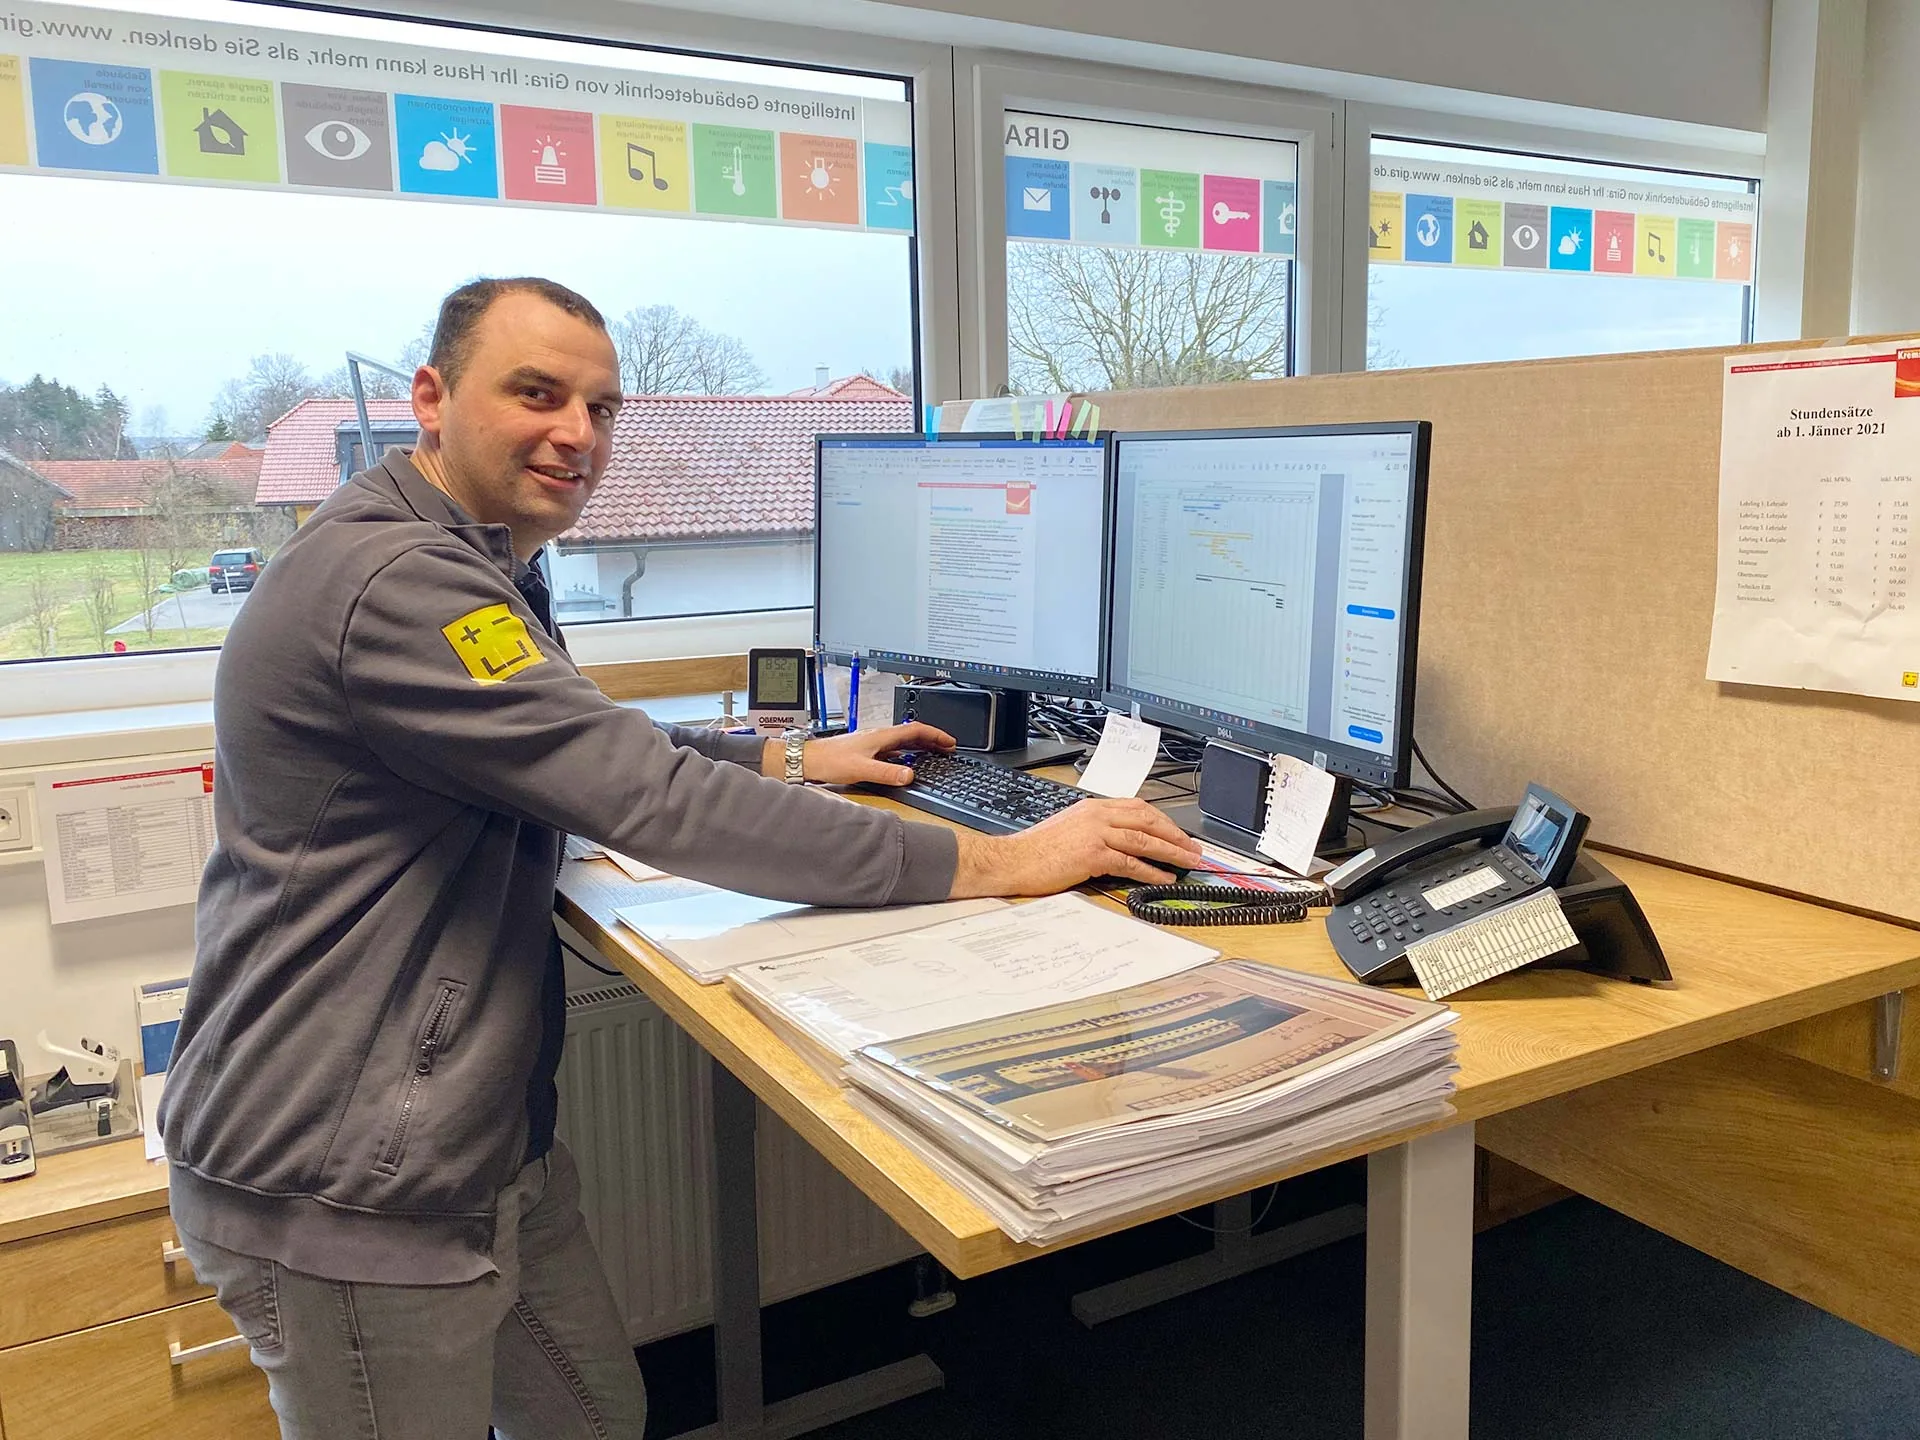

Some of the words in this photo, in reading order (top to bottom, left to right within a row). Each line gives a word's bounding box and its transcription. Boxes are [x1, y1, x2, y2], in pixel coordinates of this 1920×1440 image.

[1898, 350, 1920, 360] Krem
[1790, 406, 1874, 421] Stundensätze
[1776, 426, 1792, 438] ab
[1795, 426, 1806, 438] 1.
[1808, 424, 1854, 438] Jänner
[1856, 422, 1886, 436] 2021
[935, 669, 952, 679] DELL
[758, 716, 795, 724] OBERMAIR
[1217, 726, 1233, 740] DELL
